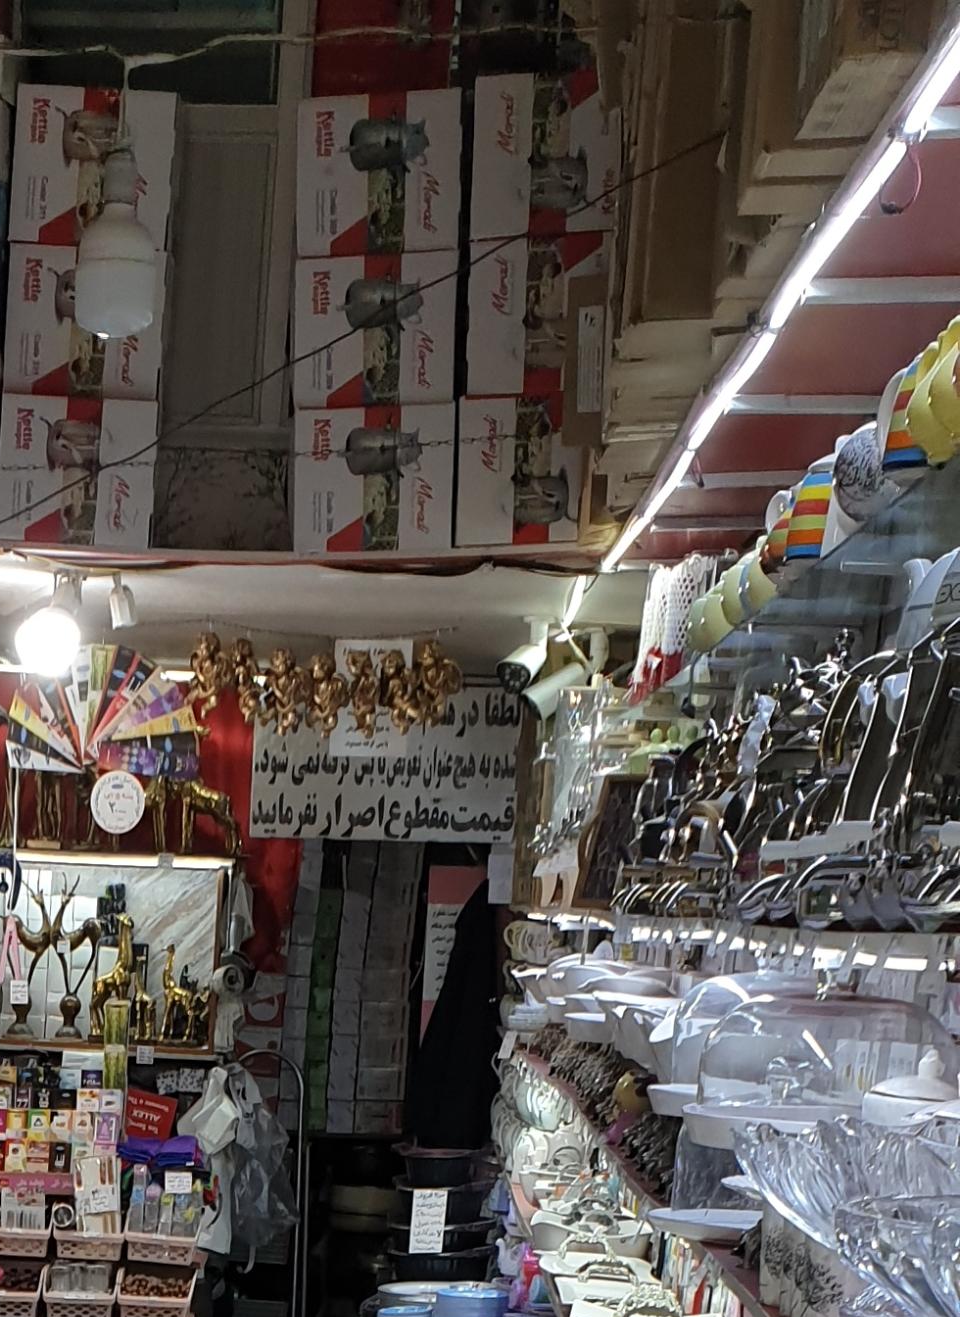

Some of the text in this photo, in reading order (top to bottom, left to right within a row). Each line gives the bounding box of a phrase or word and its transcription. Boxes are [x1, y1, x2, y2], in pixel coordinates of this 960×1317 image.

[33, 98, 51, 144] Kettle
[316, 111, 335, 158] Kettle
[312, 271, 331, 315] Kettle
[16, 407, 35, 450] Kettle
[456, 700, 479, 737] در
[485, 692, 520, 727] لطفا
[453, 753, 476, 789] هیچ
[479, 753, 491, 789] به
[252, 792, 516, 841] قیمت مقطوع اصرار نفرمایید
